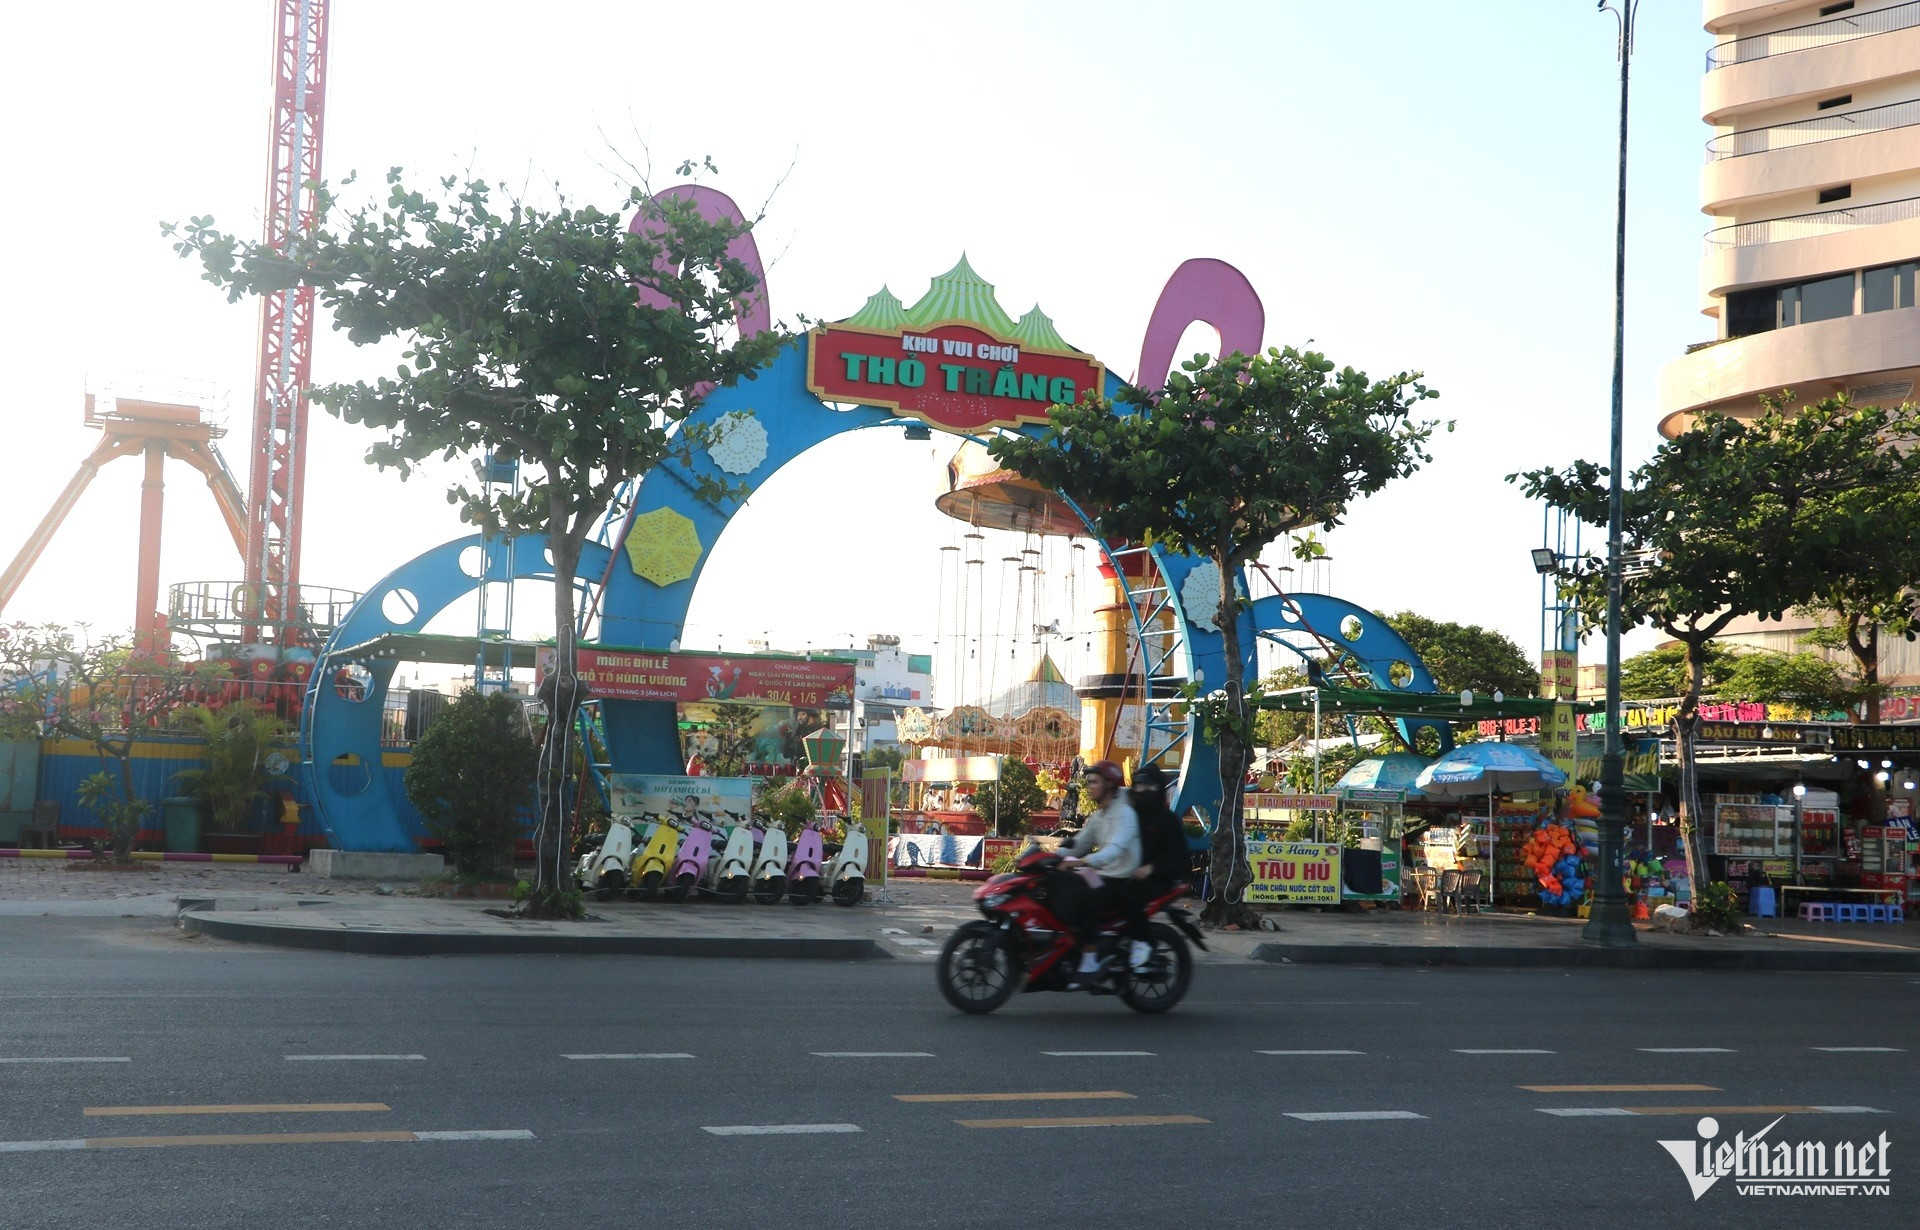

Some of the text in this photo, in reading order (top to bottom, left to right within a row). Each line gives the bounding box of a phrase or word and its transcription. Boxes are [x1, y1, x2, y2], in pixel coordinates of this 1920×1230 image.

[902, 335, 938, 353] KHU
[943, 340, 973, 358] VUI
[596, 655, 668, 670] MỪNG ĐẠI LỄ
[616, 672, 647, 684] HÙNG
[649, 675, 686, 686] VƯƠNG
[767, 690, 790, 702] 30/4
[800, 692, 816, 704] 1/5
[1267, 844, 1283, 854] Cô
